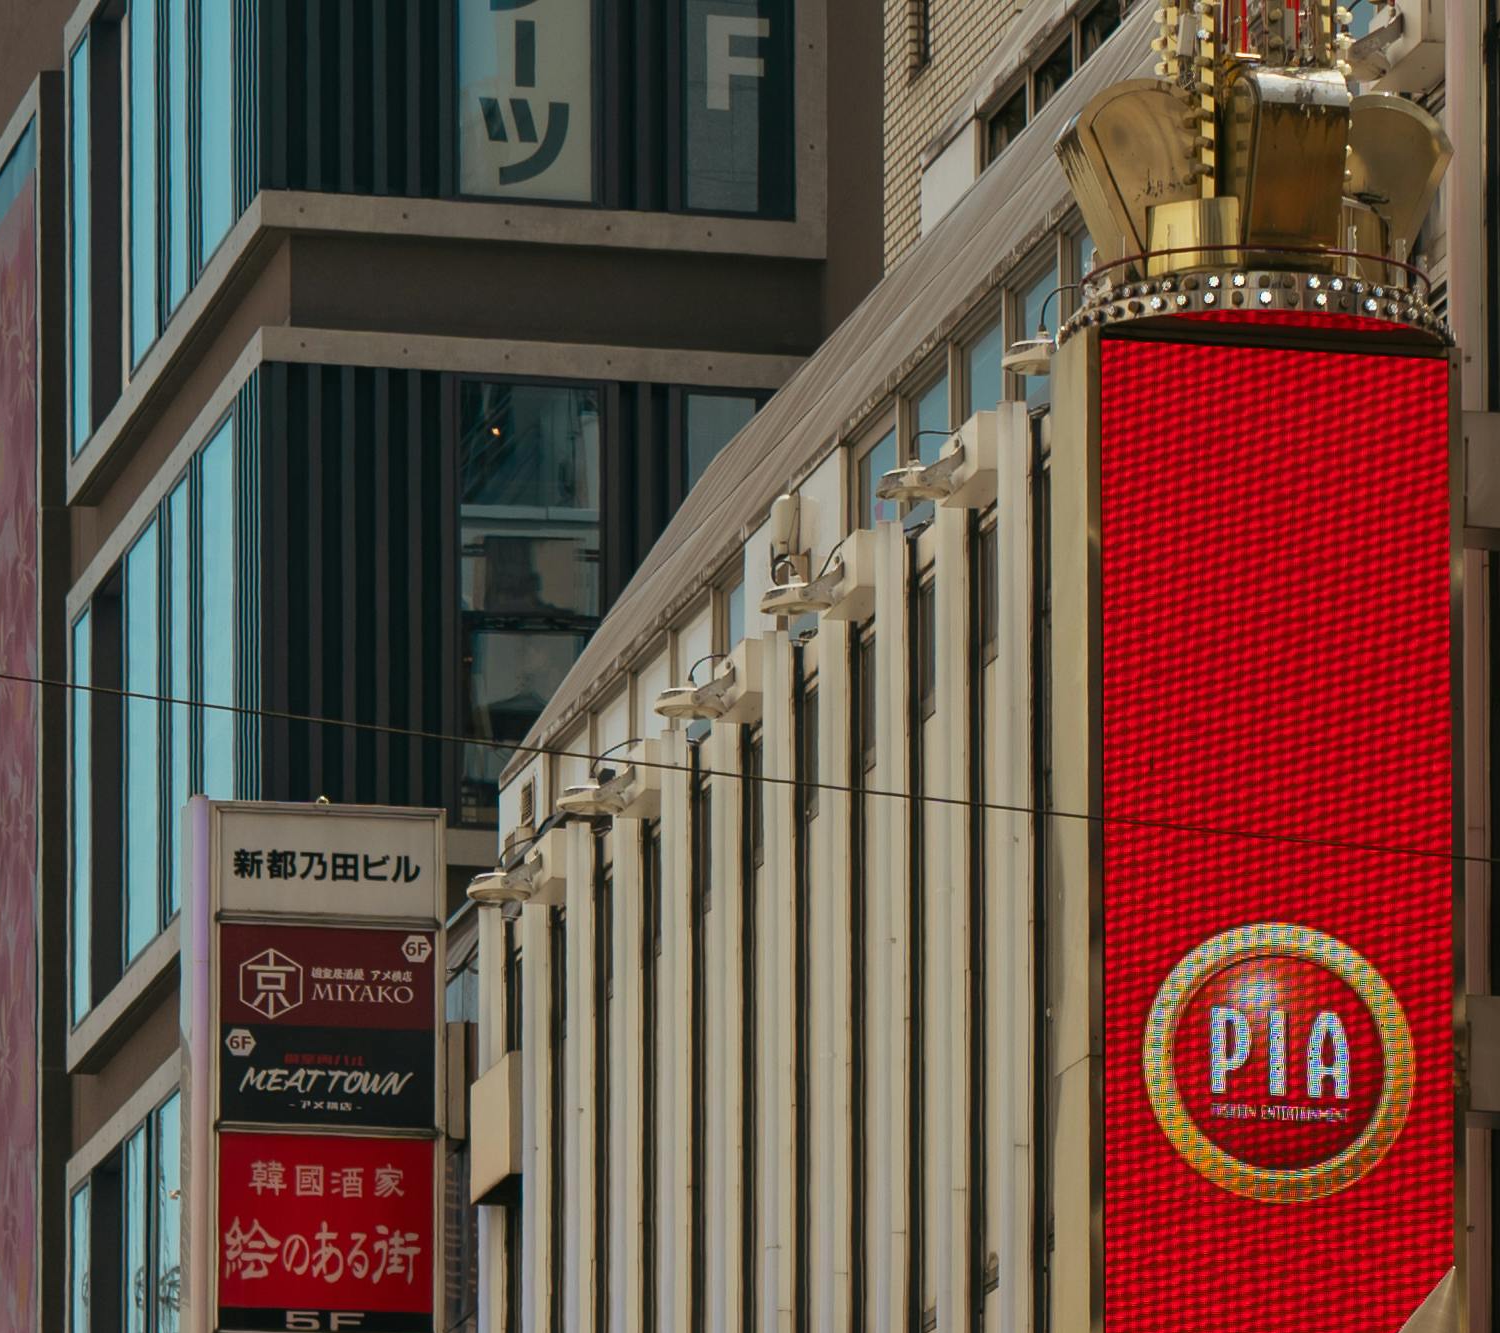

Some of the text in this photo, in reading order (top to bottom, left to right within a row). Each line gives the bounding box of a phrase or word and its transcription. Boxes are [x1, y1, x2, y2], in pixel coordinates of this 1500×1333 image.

[406, 941, 428, 957] 6F
[311, 984, 414, 1004] MIYAKO
[229, 1035, 252, 1050] 6F
[1209, 1004, 1350, 1100] PIA
[239, 1067, 414, 1096] MEAT TOWN
[248, 1160, 405, 1199] 韓國酒家
[225, 1215, 421, 1285] 絵のある街
[285, 1311, 365, 1331] 5F
